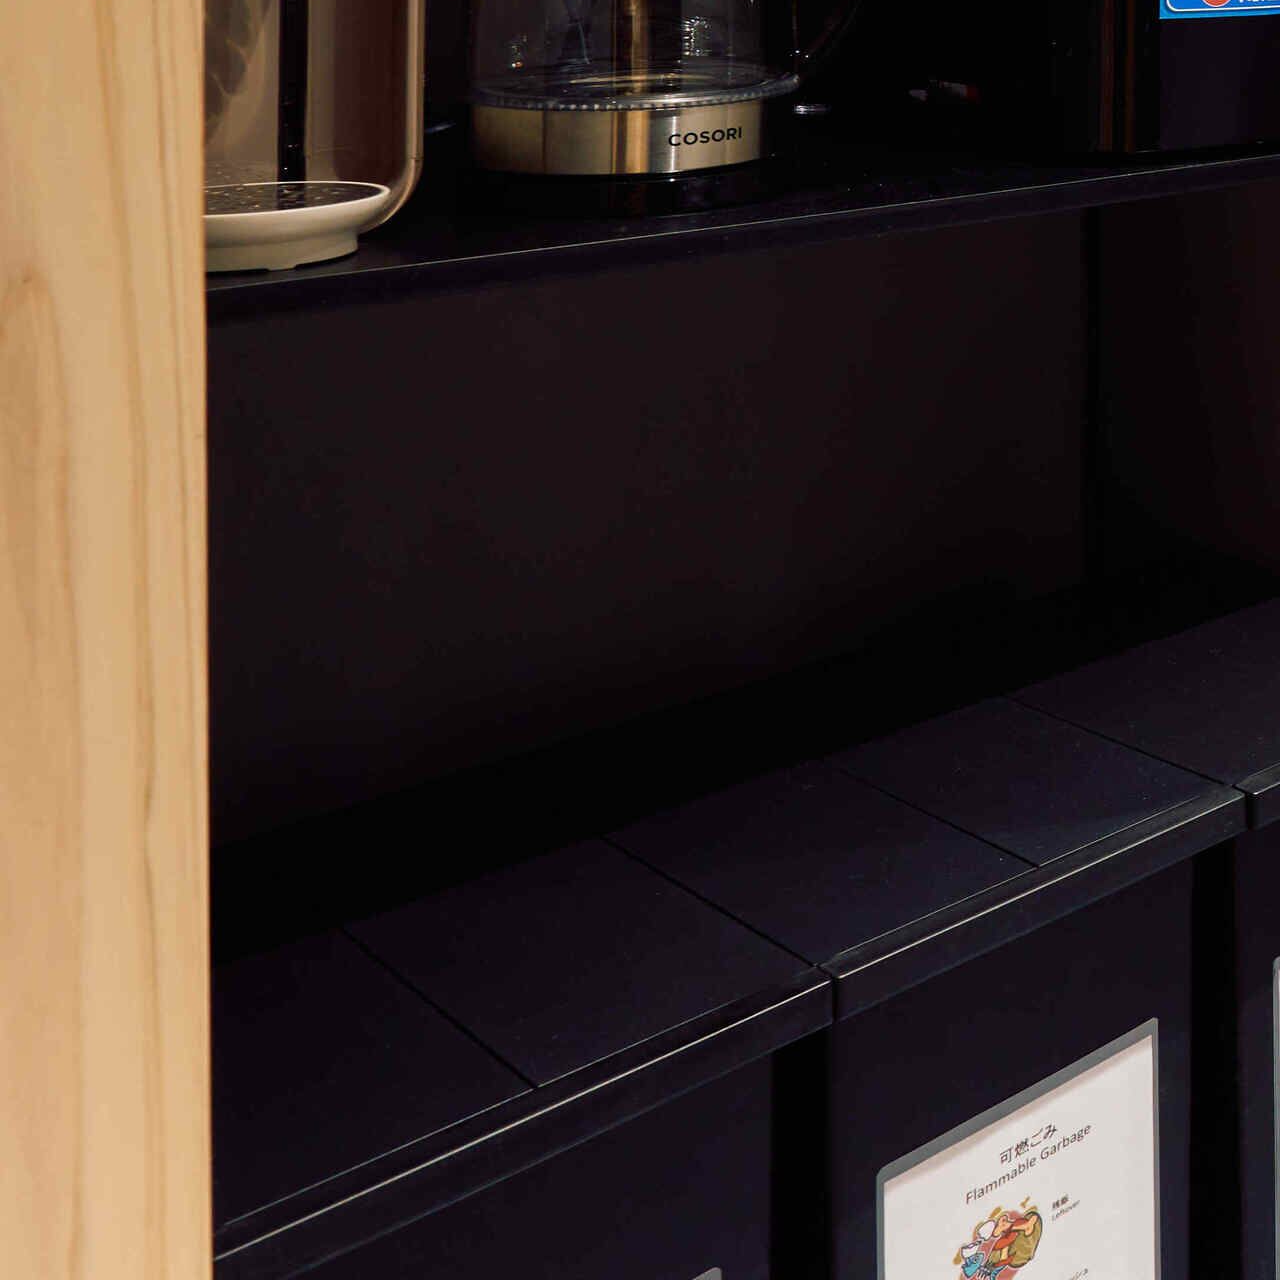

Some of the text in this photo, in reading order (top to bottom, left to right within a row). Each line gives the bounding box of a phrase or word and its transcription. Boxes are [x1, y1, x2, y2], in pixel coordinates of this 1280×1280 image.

[668, 126, 742, 146] COSORI
[1000, 1123, 1058, 1164] 可燃ごみ
[966, 1125, 1092, 1204] Flammable Garbage
